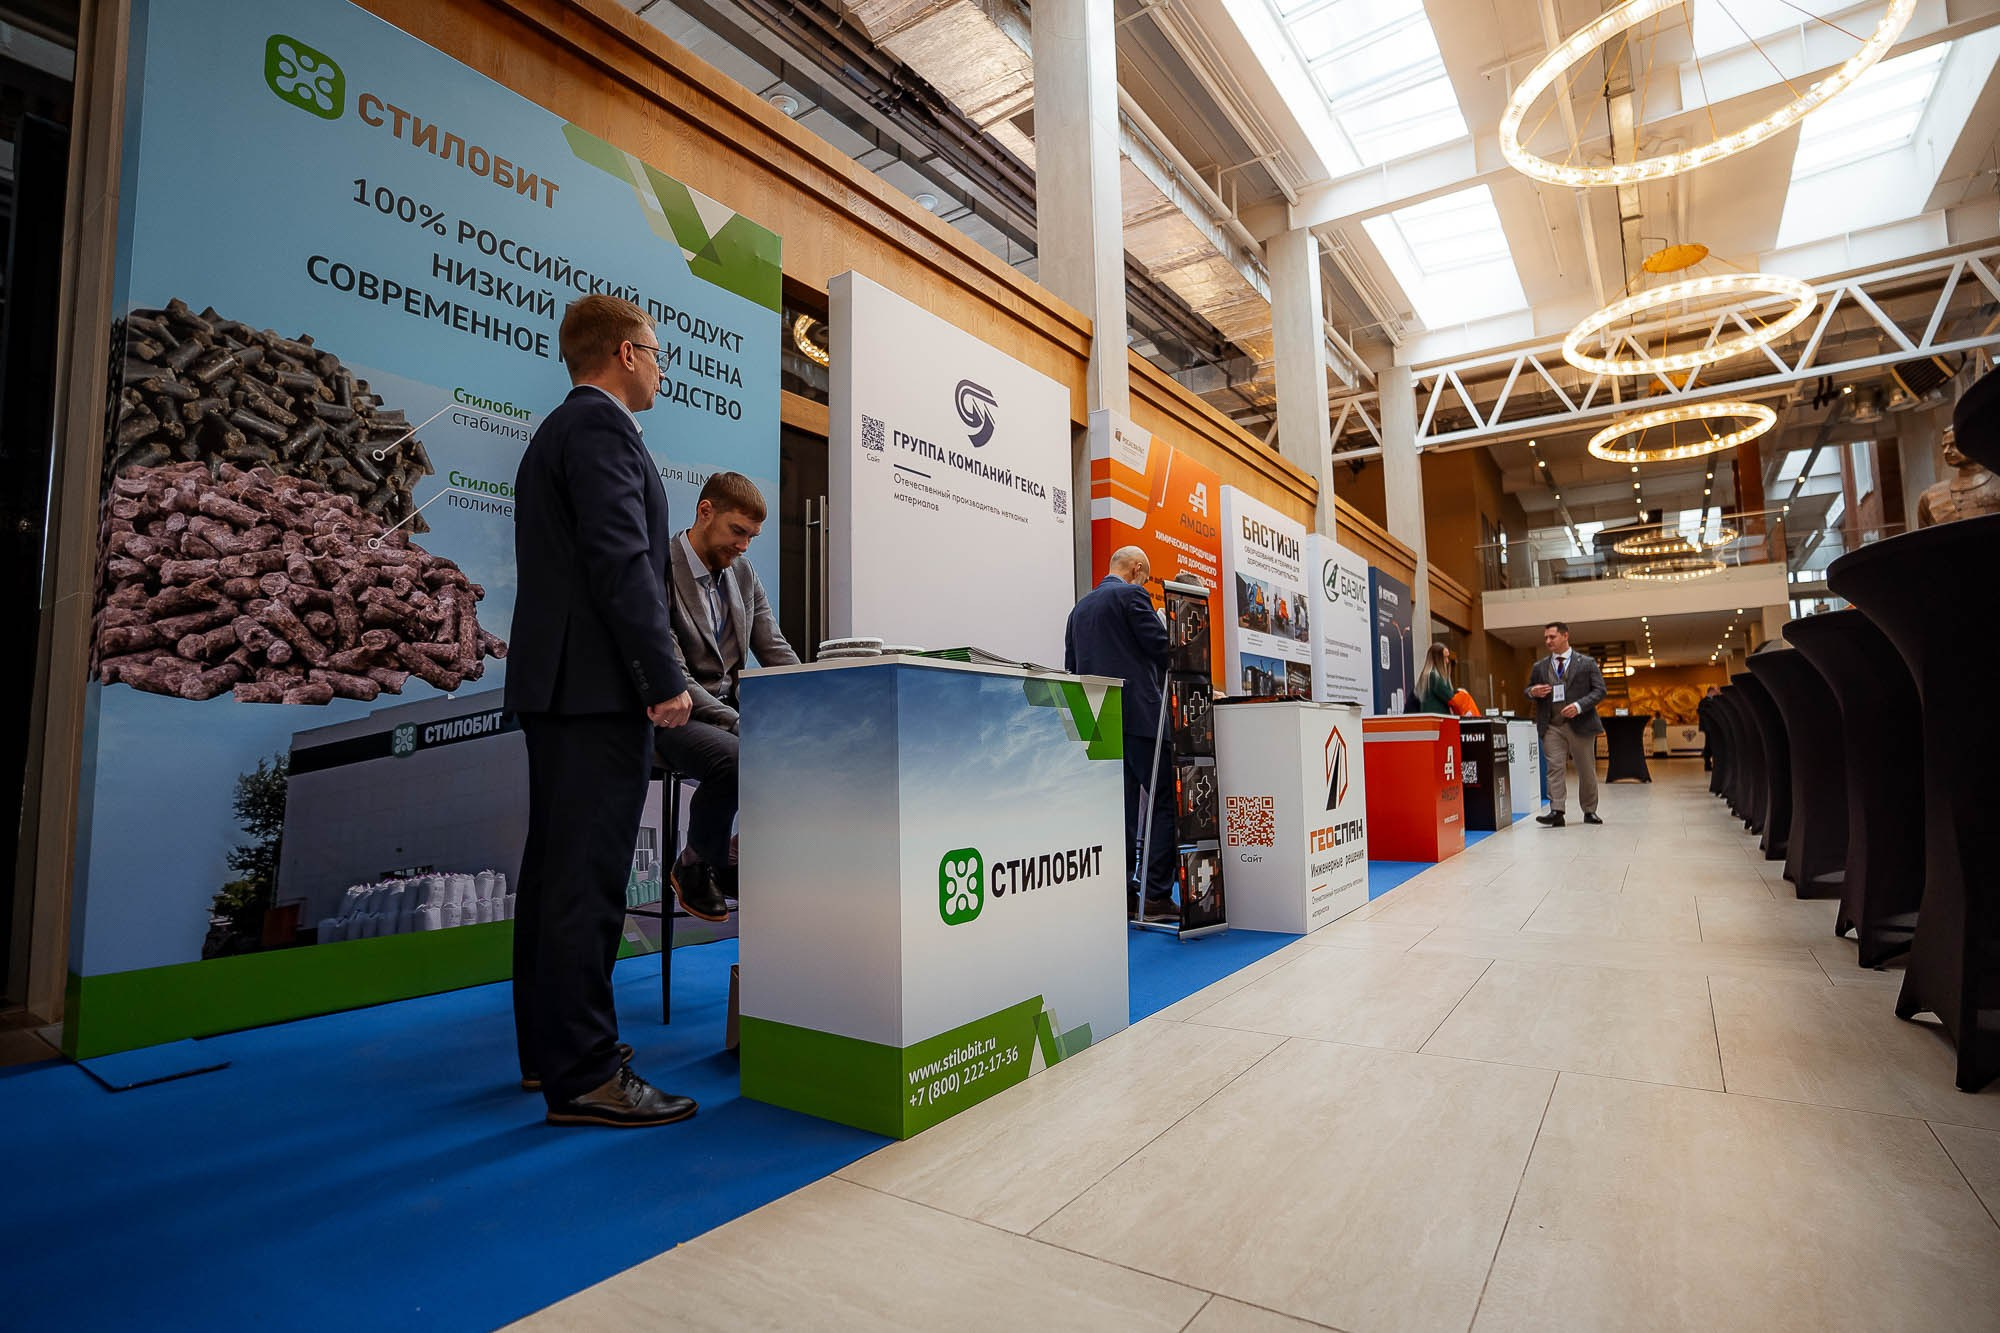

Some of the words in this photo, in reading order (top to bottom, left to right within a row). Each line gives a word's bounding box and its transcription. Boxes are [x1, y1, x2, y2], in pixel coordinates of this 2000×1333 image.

[358, 92, 560, 209] СТИЛОБИТ
[353, 178, 447, 237] 100%
[457, 219, 639, 305] РОССИЙСКИЙ
[648, 298, 744, 353] ПРОДУКТ
[306, 254, 549, 359] СОВРЕМЕННОЕ
[432, 252, 555, 321] НИЗКИЙ
[689, 350, 743, 388] ЦЕНА
[454, 387, 532, 421] Стилобит
[866, 453, 880, 464] Сайт
[893, 430, 946, 464] ГРУППА
[948, 450, 1012, 487] КОМПАНИЙ
[1015, 475, 1046, 500] ГЕКСА
[449, 470, 516, 497] Стилоби
[660, 467, 683, 480] для
[687, 470, 710, 487] ЩМ
[893, 472, 951, 500] Отечественный
[952, 494, 1000, 515] производитель
[448, 495, 513, 518] полиме
[894, 492, 940, 512] материалов
[1180, 512, 1216, 538] АМДОР
[1341, 575, 1367, 604] БАЗИС
[424, 711, 503, 744] СТИЛОБИТ
[1461, 733, 1485, 742] ТИОН
[1310, 818, 1364, 854] ГЕОСПАН
[991, 845, 1103, 898] СТИЛОБИТ
[1240, 853, 1263, 864] Сайт
[1310, 857, 1343, 878] Инженерные
[1345, 849, 1364, 869] решения
[908, 1035, 996, 1085] www.stilobit.ru
[909, 1087, 926, 1108] +7
[928, 1073, 960, 1105] (800)
[963, 1045, 1019, 1087] 222-17-36
